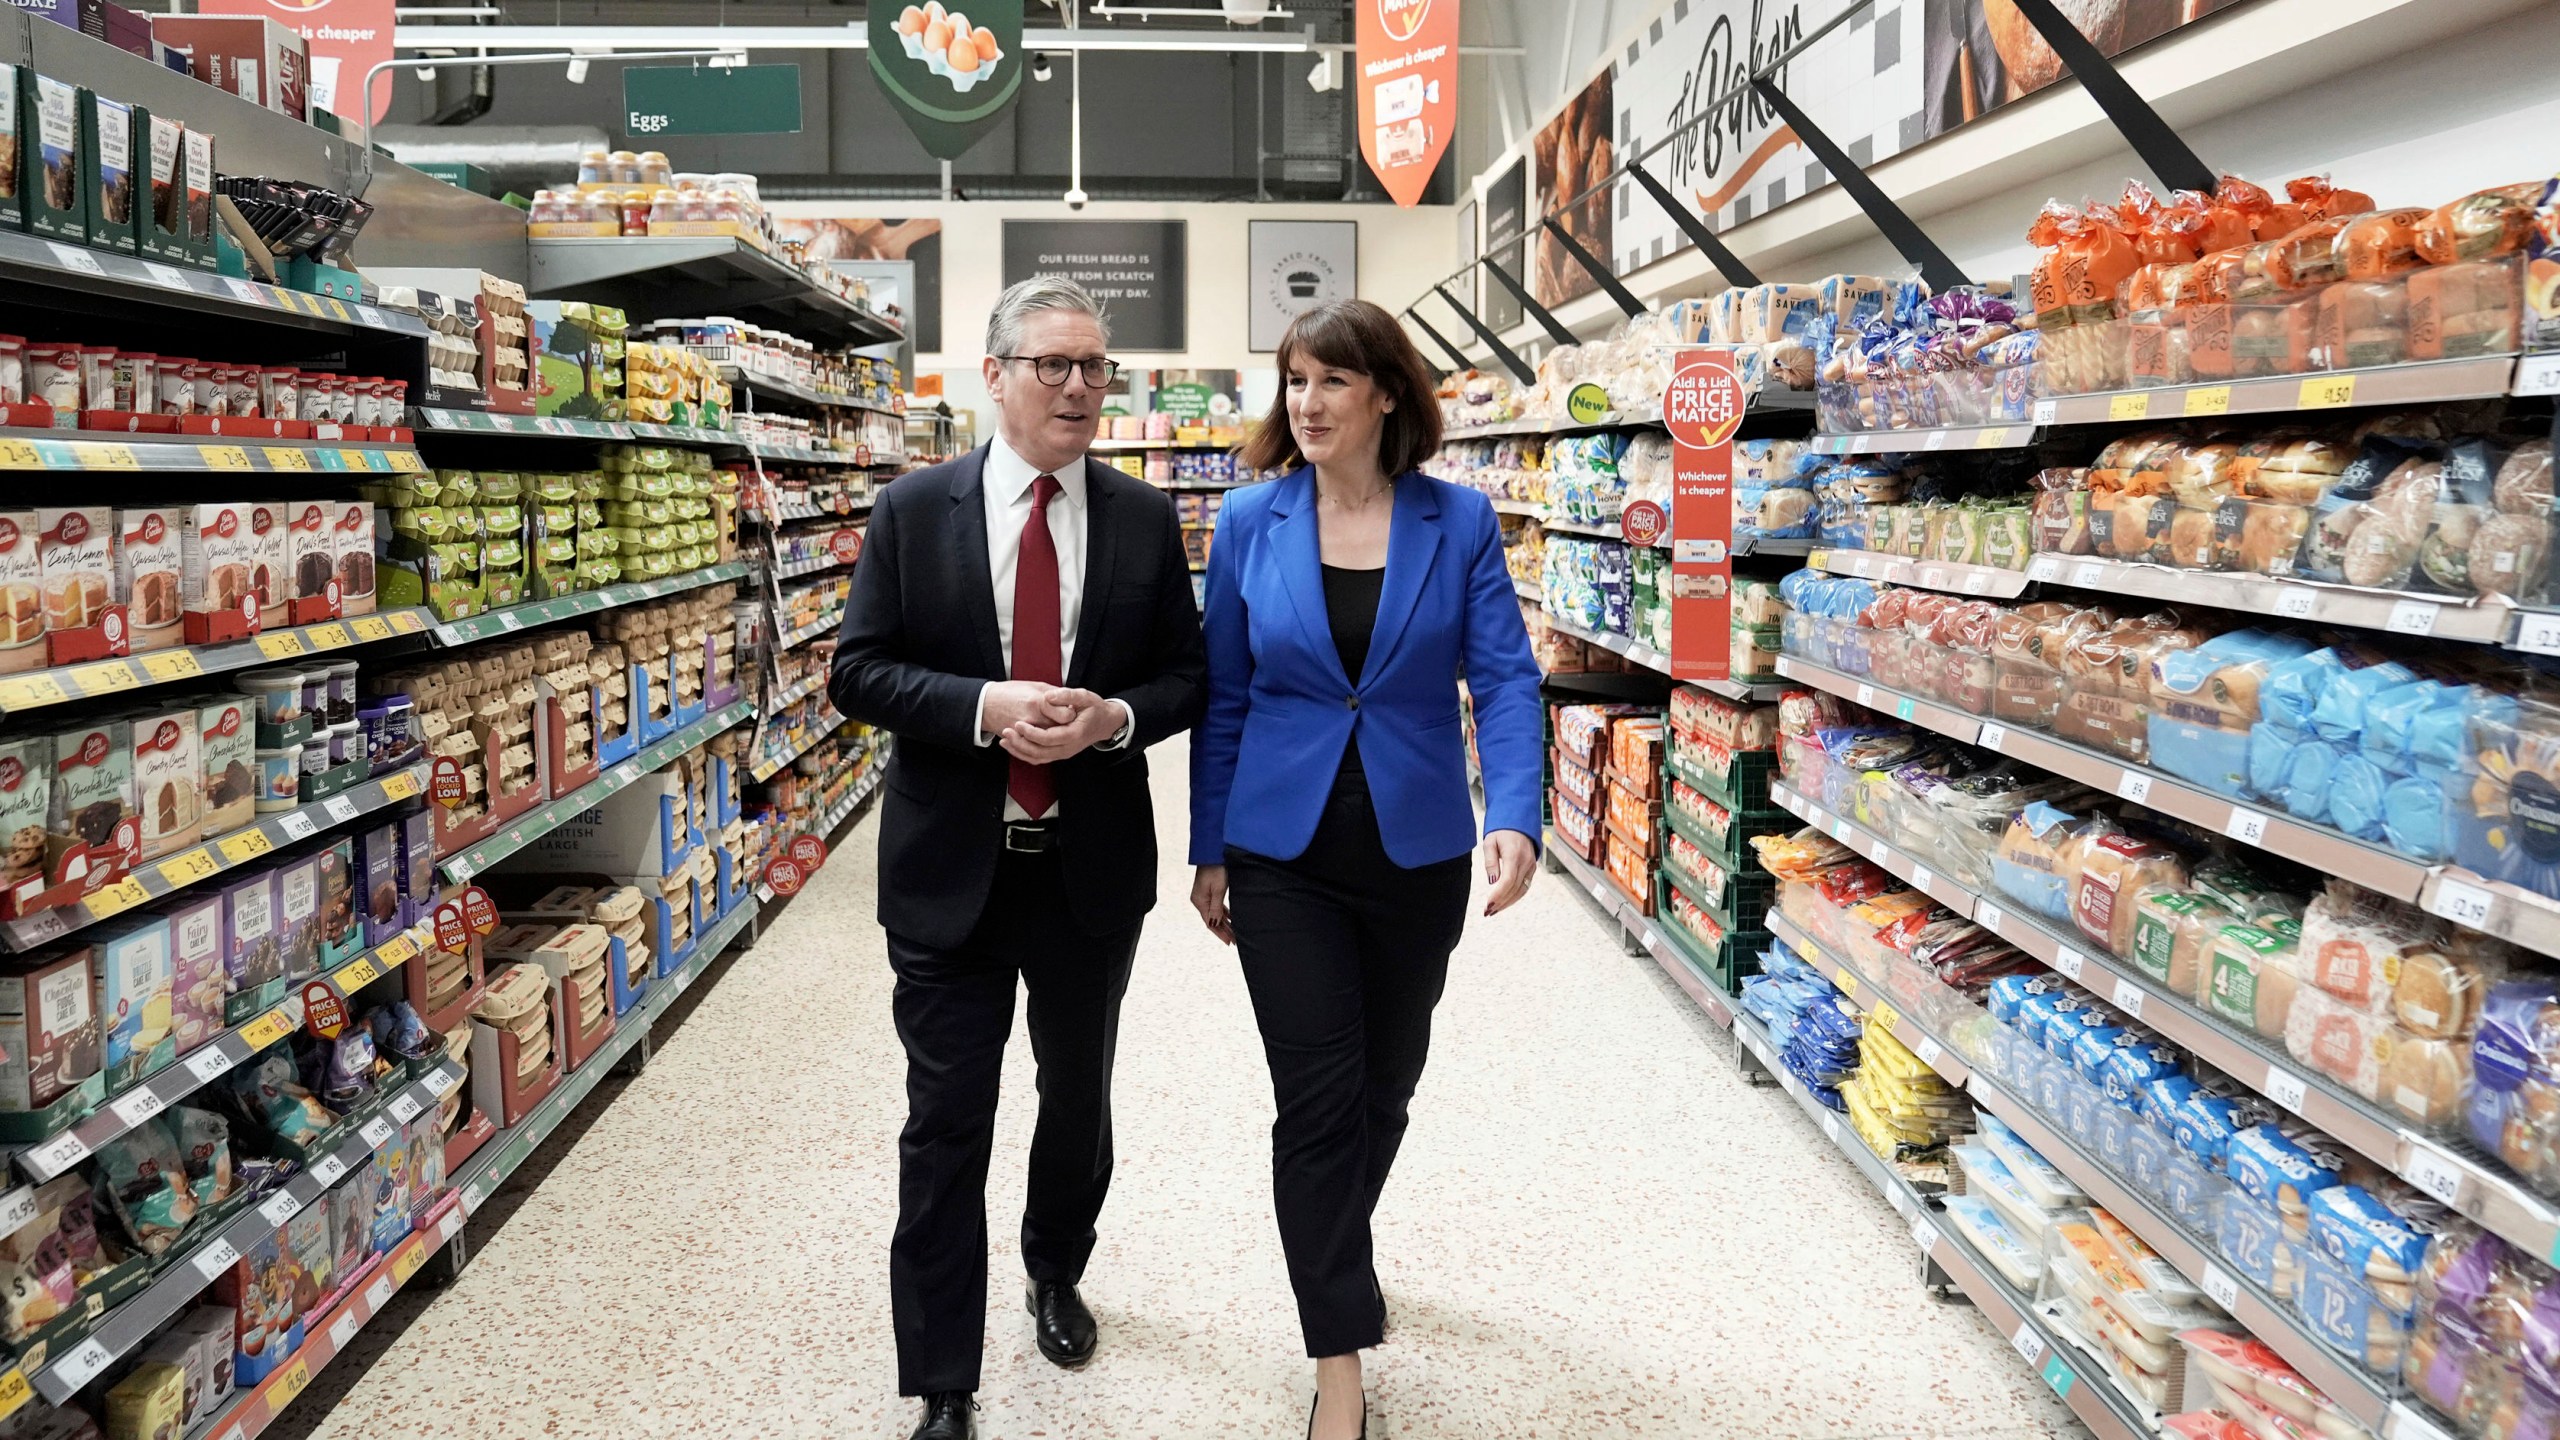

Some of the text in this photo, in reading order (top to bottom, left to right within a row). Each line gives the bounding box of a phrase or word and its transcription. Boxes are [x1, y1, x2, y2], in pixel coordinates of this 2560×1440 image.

[302, 25, 376, 43] is cheaper
[1365, 45, 1447, 77] Whichever is cheaper
[630, 112, 668, 133] Eggs
[1667, 70, 1699, 193] The
[1039, 254, 1149, 264] OUR FRESH BREAD IS
[1273, 252, 1334, 274] BAKED FROM
[1072, 272, 1102, 281] FROM
[1106, 272, 1154, 281] SCRATCH
[1091, 289, 1150, 298] EVERY DAY.
[1672, 376, 1731, 389] Aldi & Lidl
[1671, 390, 1733, 408] PRICE
[2325, 387, 2350, 404] £1.50
[1573, 397, 1605, 412] New
[1671, 408, 1733, 423] MATCH
[1678, 471, 1727, 482] Whichever
[1679, 486, 1725, 497] is cheaper
[1598, 495, 1622, 503] HOVIS
[222, 514, 233, 522] Betty
[256, 512, 267, 520] Betty
[1632, 515, 1655, 524] PRICE
[66, 518, 81, 529] Betty
[220, 521, 236, 533] Crocker
[254, 519, 270, 530] Crocker
[1631, 523, 1655, 531] MATCH
[62, 526, 87, 540] Crocker
[145, 526, 162, 538] Crocker
[48, 545, 104, 568] Zesty Lemon
[224, 711, 235, 721] Betty
[160, 724, 173, 735] Betty
[223, 718, 239, 730] Crocker
[87, 738, 102, 748] Betty
[158, 733, 178, 747] Crocker
[84, 746, 108, 761] Crocker
[210, 734, 252, 761] Chocolate Fudge
[146, 750, 188, 775] Country Carrot
[70, 779, 100, 801] Chocolate
[438, 789, 460, 797] LOW
[297, 820, 313, 832] £1.89
[243, 840, 253, 851] 2
[540, 841, 579, 850] LARGE
[187, 861, 198, 873] 2
[371, 864, 382, 874] CAKE
[114, 890, 124, 902] 2
[286, 884, 312, 900] Chocolate
[2080, 884, 2092, 911] 6
[237, 902, 268, 920] Chocolate
[289, 899, 303, 912] CUPCAKE
[467, 902, 489, 914] PRICE
[470, 909, 491, 919] LOCKED
[472, 914, 493, 927] LOW
[242, 914, 266, 931] CUPCAKE KIT
[440, 922, 462, 932] PRICE
[188, 924, 208, 938] Fairy
[442, 928, 464, 938] LOCKED
[2137, 924, 2149, 951] 4
[190, 939, 200, 950] CAKE
[444, 934, 466, 946] LOW
[355, 966, 375, 982] £2.25
[2214, 964, 2228, 996] 4
[133, 975, 144, 988] CAKE
[45, 977, 84, 1003] Chocolate
[309, 999, 336, 1013] PRICE
[312, 1006, 339, 1019] LOCKED
[57, 1009, 68, 1021] CAKE
[315, 1013, 341, 1028] LOW
[205, 1055, 226, 1072] £1.49
[436, 1074, 450, 1088] £1.89
[134, 1096, 158, 1113] £1.89
[402, 1101, 417, 1115] £1.89
[373, 1123, 390, 1138] £1.99
[54, 1142, 82, 1162] £2.25
[326, 1160, 341, 1174] 89p
[8, 1200, 35, 1221] £1.95
[277, 1199, 296, 1213] £1.39
[214, 1250, 235, 1264] £1.35
[408, 1250, 425, 1269] £1.50
[383, 1283, 390, 1295] £2
[2322, 1289, 2344, 1334] 12
[349, 1320, 356, 1331] £2
[83, 1351, 106, 1368] 69p
[288, 1369, 307, 1392] £1.50
